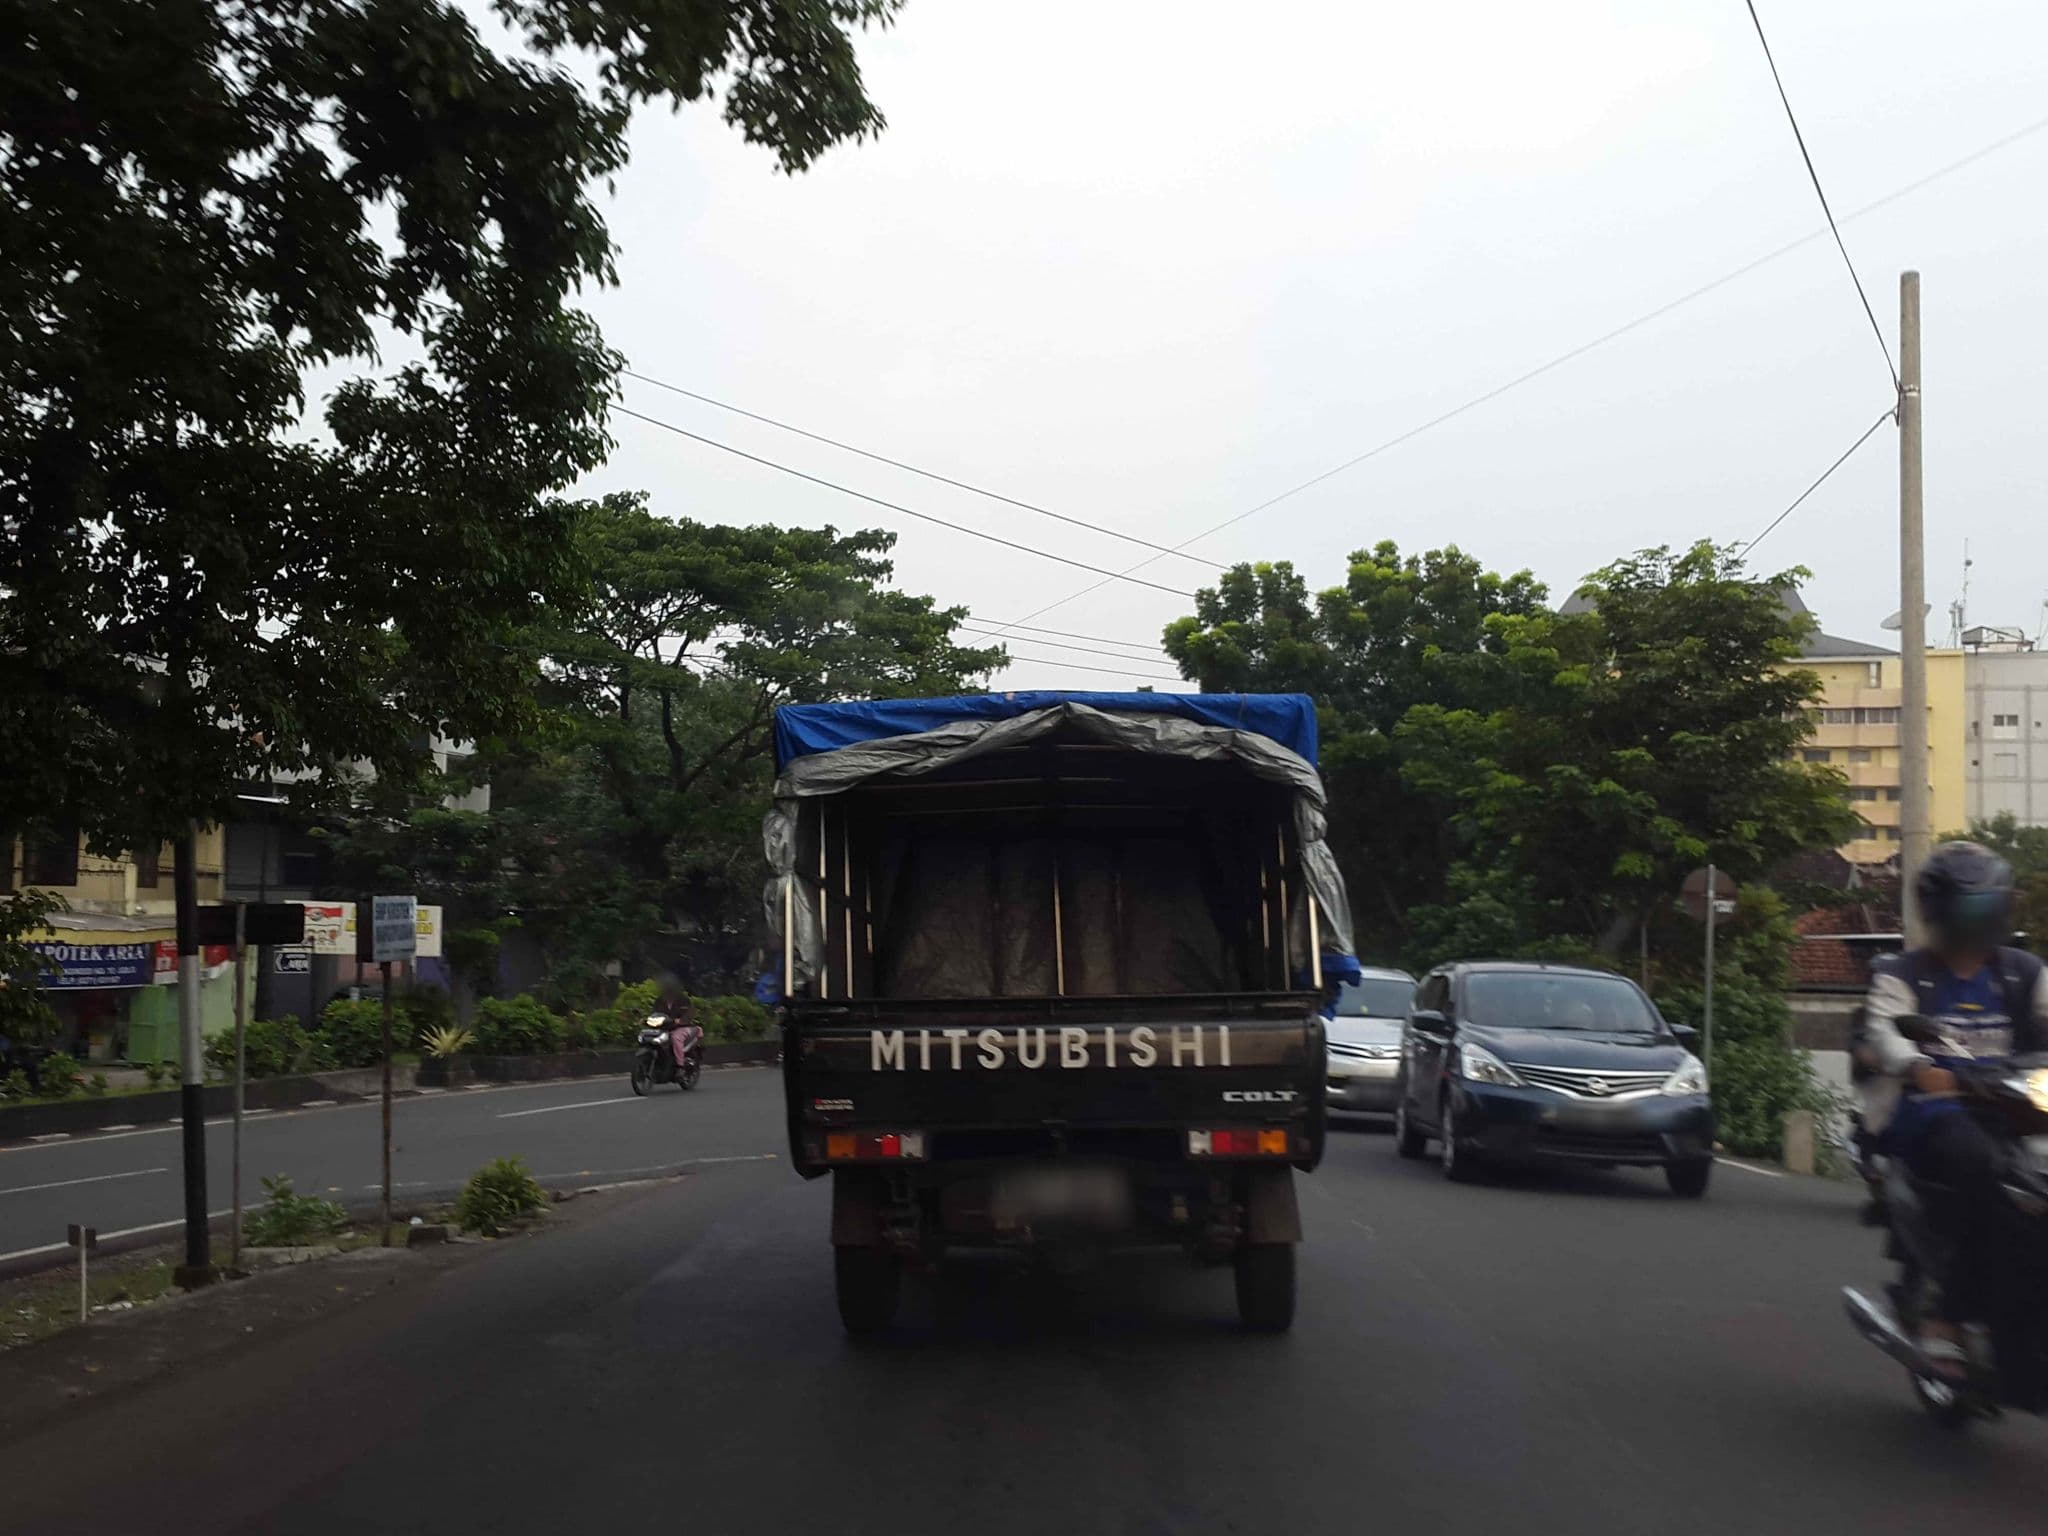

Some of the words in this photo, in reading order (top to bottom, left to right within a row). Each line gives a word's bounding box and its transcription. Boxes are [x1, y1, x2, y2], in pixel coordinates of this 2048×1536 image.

[34, 945, 103, 961] APOTEK
[871, 1025, 1231, 1071] MITSUBISHI
[1222, 1090, 1299, 1102] COLT
